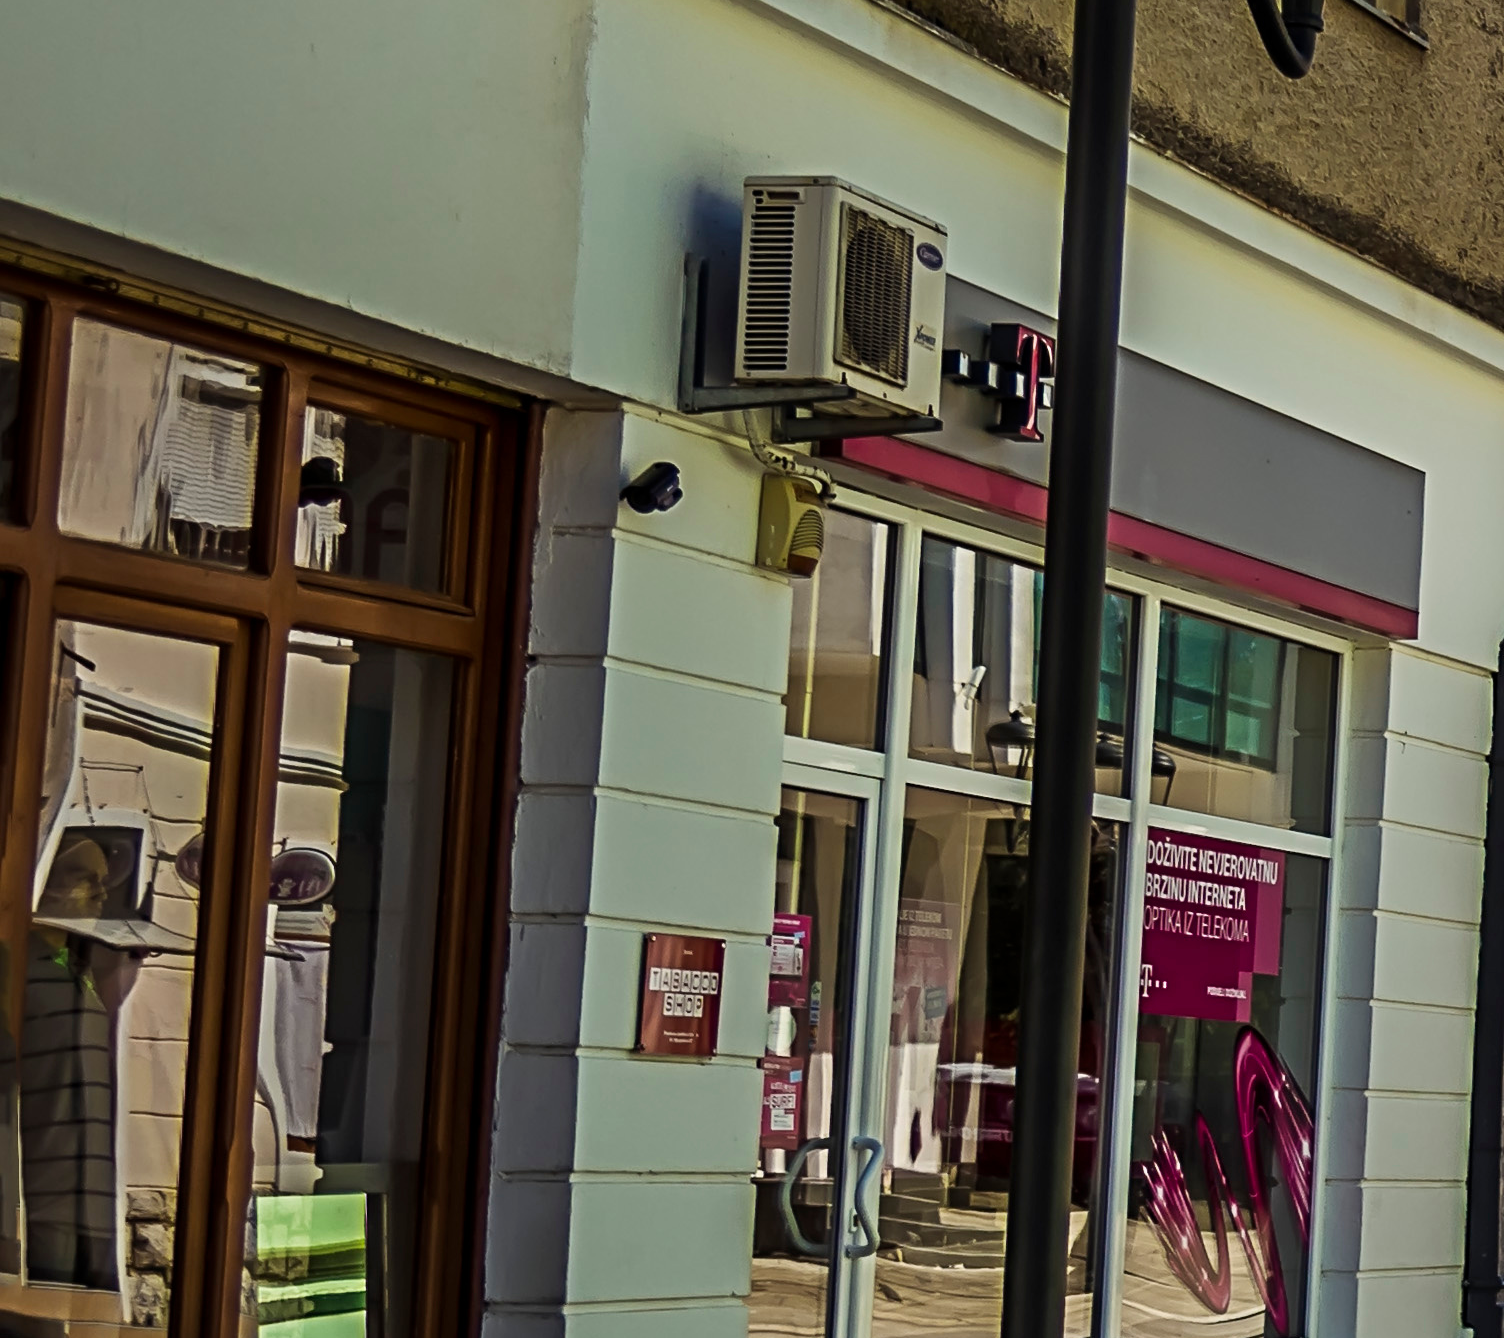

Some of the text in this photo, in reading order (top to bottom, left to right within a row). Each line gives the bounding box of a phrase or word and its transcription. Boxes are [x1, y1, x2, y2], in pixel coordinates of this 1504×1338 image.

[1147, 836, 1279, 886] DOŽIVITE NEVJEROVATNU
[1145, 872, 1247, 912] BRZINU INTERNETA
[1143, 905, 1250, 943] OPTIKA IZ TELEKOMA
[663, 992, 704, 1017] SHOP
